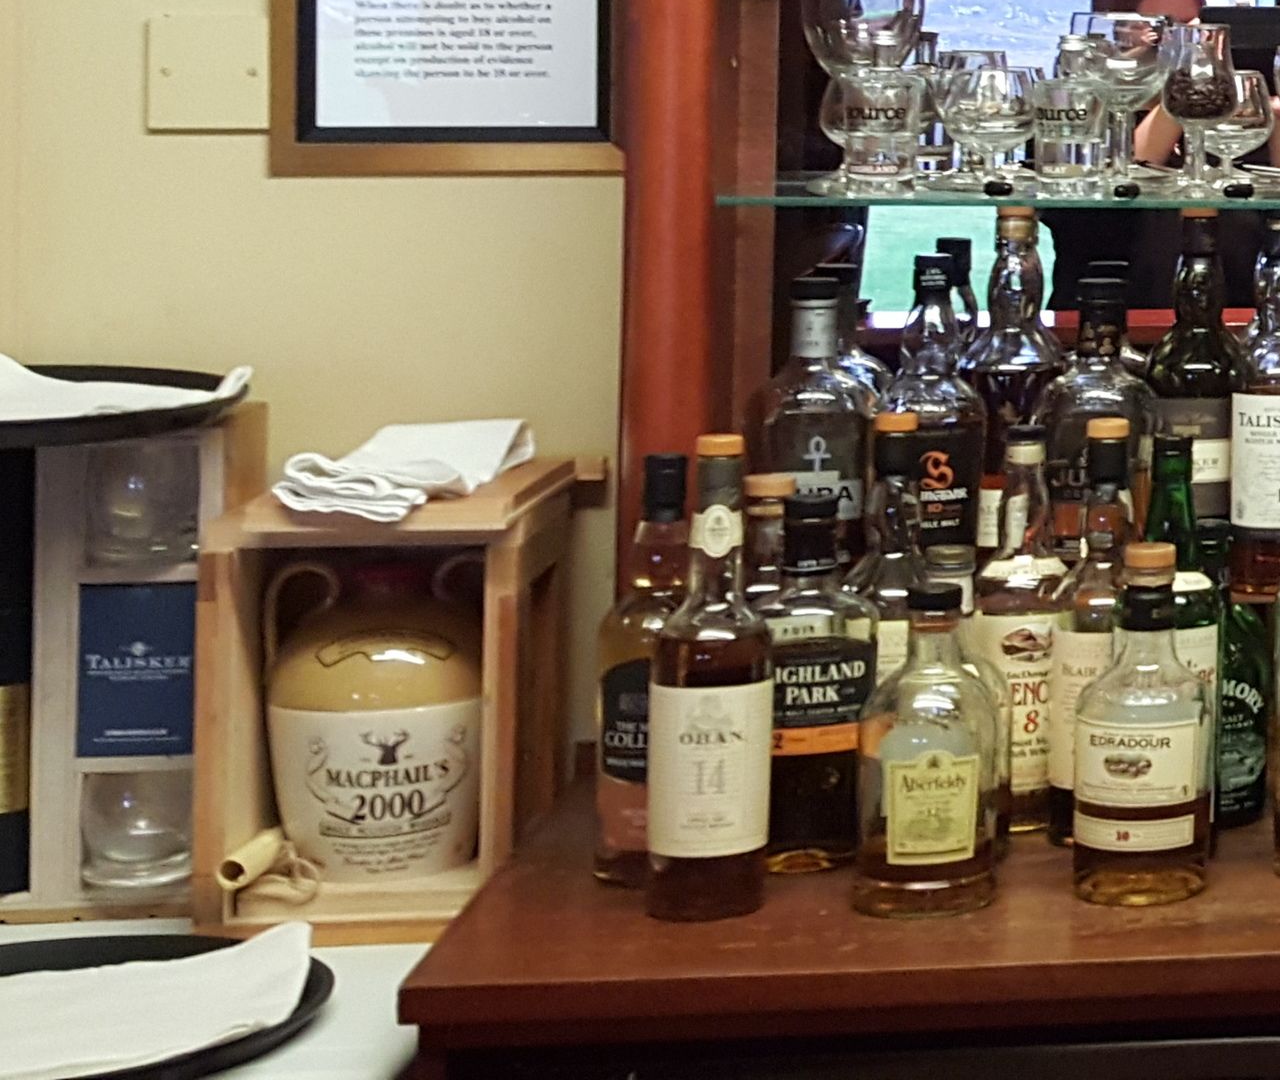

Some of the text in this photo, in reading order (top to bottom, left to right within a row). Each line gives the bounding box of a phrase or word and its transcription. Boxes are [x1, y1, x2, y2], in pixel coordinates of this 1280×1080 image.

[87, 654, 190, 670] TALISKER
[786, 686, 839, 705] PARK
[1023, 709, 1039, 734] 8
[1090, 734, 1171, 749] EDRADOUR
[326, 758, 450, 789] MACPHAIL'S
[690, 762, 725, 796] 14
[902, 772, 967, 793] Aberfeldy
[352, 789, 424, 820] 2000
[1115, 830, 1130, 841] 10
